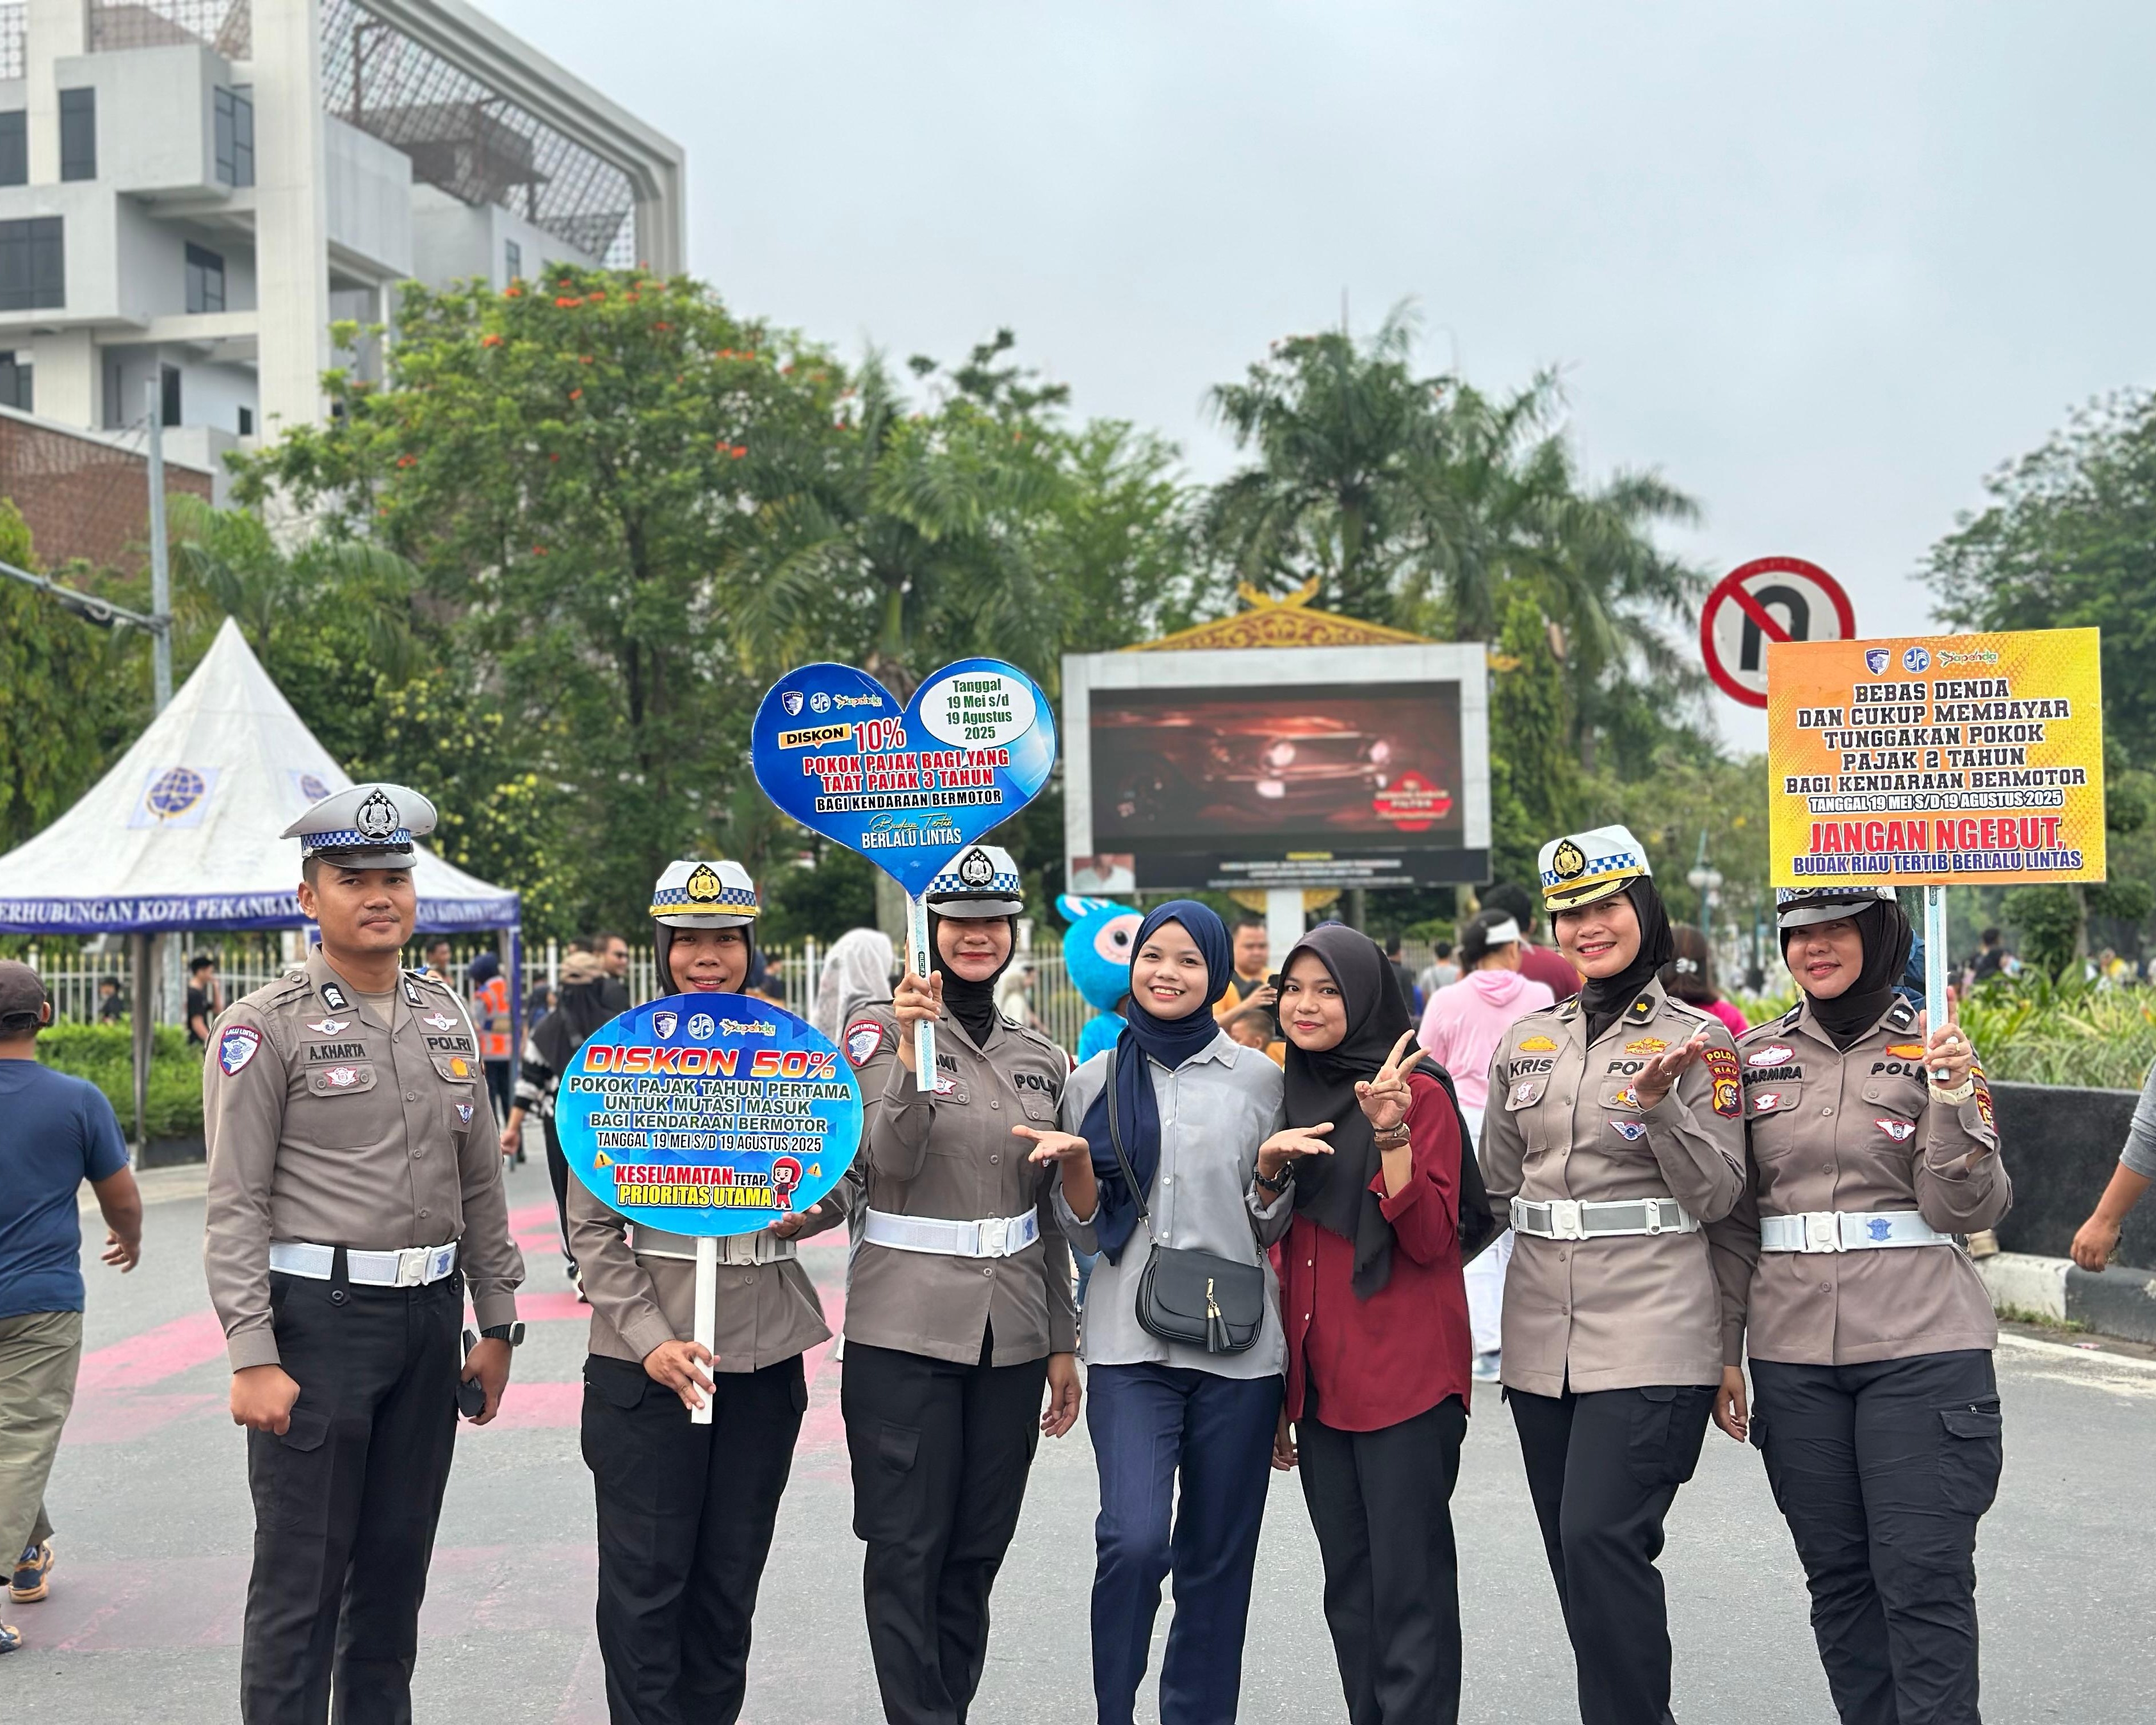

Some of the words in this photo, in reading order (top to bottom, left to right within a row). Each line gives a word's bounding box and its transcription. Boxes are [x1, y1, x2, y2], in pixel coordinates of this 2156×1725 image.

[953, 678, 1001, 693] Tanggal
[1856, 683, 1926, 702] BEBAS
[1935, 679, 2009, 699] DENDA
[947, 696, 961, 708] 19
[964, 695, 986, 708] Mei
[989, 694, 1009, 707] s/d
[946, 712, 959, 724] 19
[963, 711, 1012, 725] Agustus
[1798, 710, 1843, 727] DAN
[1851, 706, 1926, 726] CUKUP
[1935, 699, 2070, 723] MEMBAYAR
[787, 727, 844, 744] DISKON
[854, 718, 905, 751] 10%
[964, 726, 995, 740] 2025
[1825, 727, 1960, 749] TUNGGAKAN
[1969, 723, 2043, 743] POKOK
[805, 757, 860, 774] POKOK
[866, 755, 915, 771] PAJAK
[921, 752, 962, 768] BAGI
[967, 749, 1009, 766] YANG
[1843, 752, 1918, 771] PAJAK
[1926, 751, 1939, 768] 2
[1948, 747, 2025, 767] TAHUN
[822, 775, 862, 792] TAAT
[868, 772, 918, 791] PAJAK
[923, 771, 934, 788] 3
[939, 769, 993, 787] TAHUN
[1786, 777, 1831, 793] BAGI
[1839, 772, 1963, 792] KENDARAAN
[1972, 768, 2086, 788] BERMOTOR
[816, 797, 848, 812] BAGI
[853, 793, 927, 810] KENDARAAN
[932, 791, 1001, 807] BERMOTOR
[1809, 797, 1868, 812] TANGGAL
[1869, 796, 1886, 811] 19
[1888, 796, 1912, 811] MEI
[1915, 795, 1940, 810] S/D
[1942, 794, 1957, 808] 19
[1960, 792, 2023, 808] AGUSTUS
[2025, 791, 2062, 806] 2025
[862, 830, 917, 849] BERLALU
[919, 828, 962, 845] LINTAS
[1809, 820, 1927, 854] JANGAN
[1935, 816, 2064, 851] NGEBUT,
[1794, 855, 1850, 873] BUDAK
[1853, 855, 1889, 872] RIAU
[1894, 854, 1948, 872] TERTIB
[1953, 852, 2021, 870] BERLALU
[2025, 851, 2082, 869] LINTAS
[139, 899, 191, 922] KOTA
[310, 1043, 366, 1060] A.KHARTA
[427, 1037, 472, 1051] POLRI
[583, 1046, 739, 1076] DISKON
[751, 1050, 837, 1079] 50%
[1707, 1051, 1736, 1063] POLDA
[1510, 1058, 1553, 1078] KRIS
[571, 1077, 634, 1094] POKOK
[640, 1079, 696, 1095] PAJAK
[702, 1081, 762, 1096] TAHUN
[768, 1083, 850, 1100] PERTAMA
[606, 1095, 669, 1111] UNTUK
[675, 1098, 740, 1113] MUTASI
[747, 1099, 810, 1115] MASUK
[591, 1113, 628, 1127] BAGI
[635, 1115, 733, 1130] KENDARAAN
[741, 1117, 827, 1132] BERMOTOR
[598, 1132, 648, 1147] TANGGAL
[653, 1134, 666, 1148] 19
[670, 1134, 690, 1148] MEI
[693, 1135, 716, 1149] S/D
[720, 1135, 733, 1149] 19
[737, 1136, 790, 1151] AGUSTUS
[792, 1137, 821, 1152] 2025
[615, 1165, 732, 1185] KESELAMATAN
[734, 1174, 767, 1185] TETAP
[619, 1185, 710, 1205] PRIORITAS
[712, 1187, 773, 1206] UTAMA
